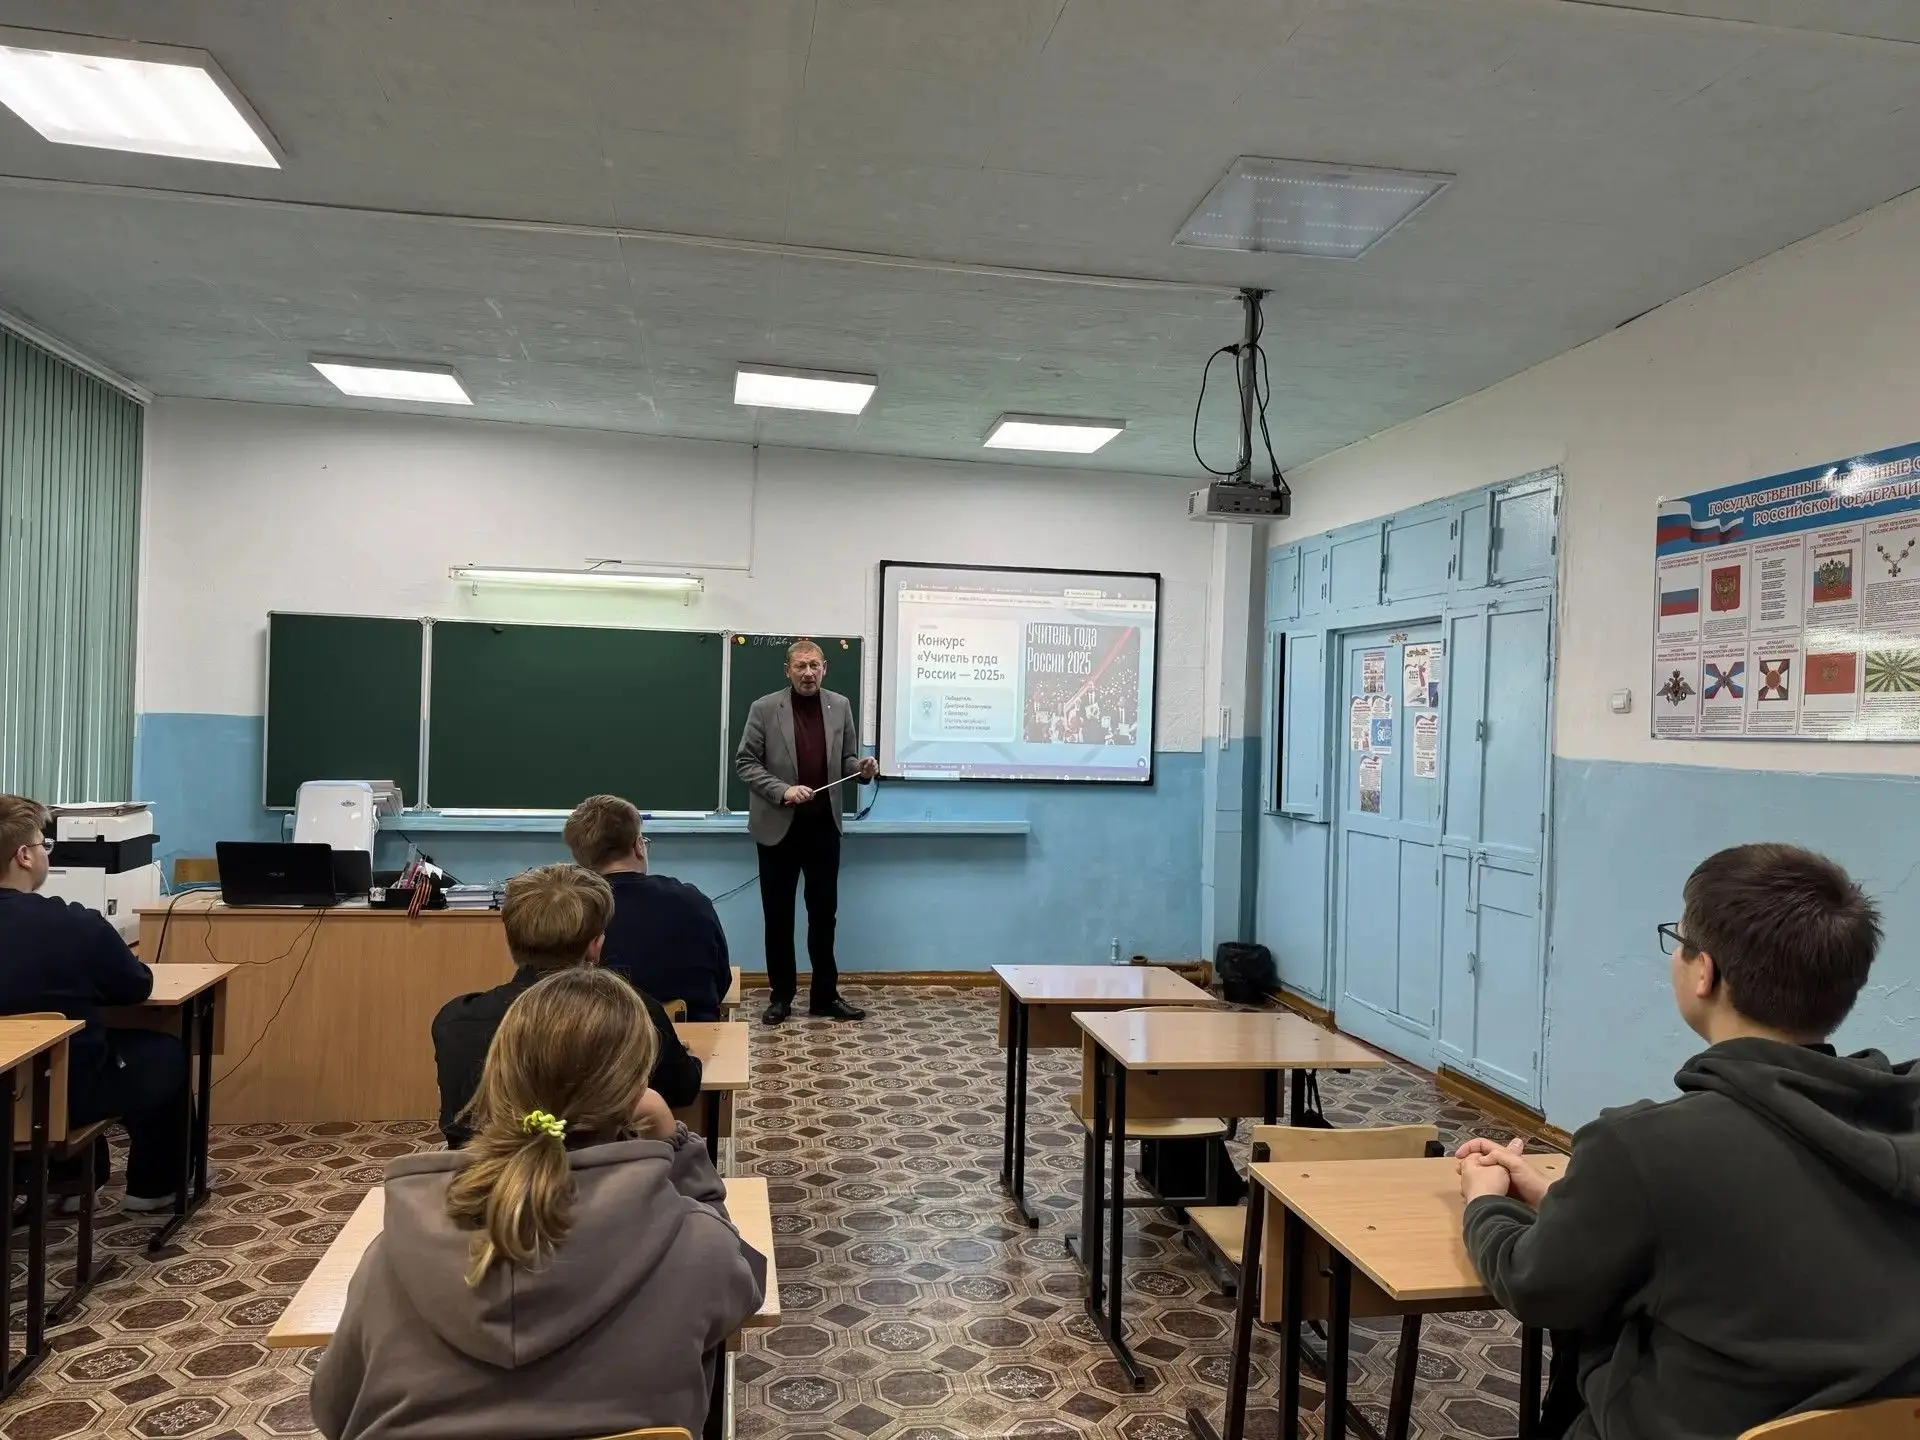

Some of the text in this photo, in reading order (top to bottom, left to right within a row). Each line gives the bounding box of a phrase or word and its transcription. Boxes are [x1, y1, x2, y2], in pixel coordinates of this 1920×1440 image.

[1708, 479, 1824, 516] ГОСУДАРСТВЕННЫЕ
[1753, 478, 1920, 526] РОССИЙСКОЙ ФЕДЕРАЦИ
[917, 633, 965, 650] Конкурс
[1028, 621, 1097, 651] Учитель года
[917, 650, 998, 667] «Учитель года
[1027, 646, 1092, 675] России 2025
[917, 667, 957, 680] России
[973, 669, 1005, 681] 2025»
